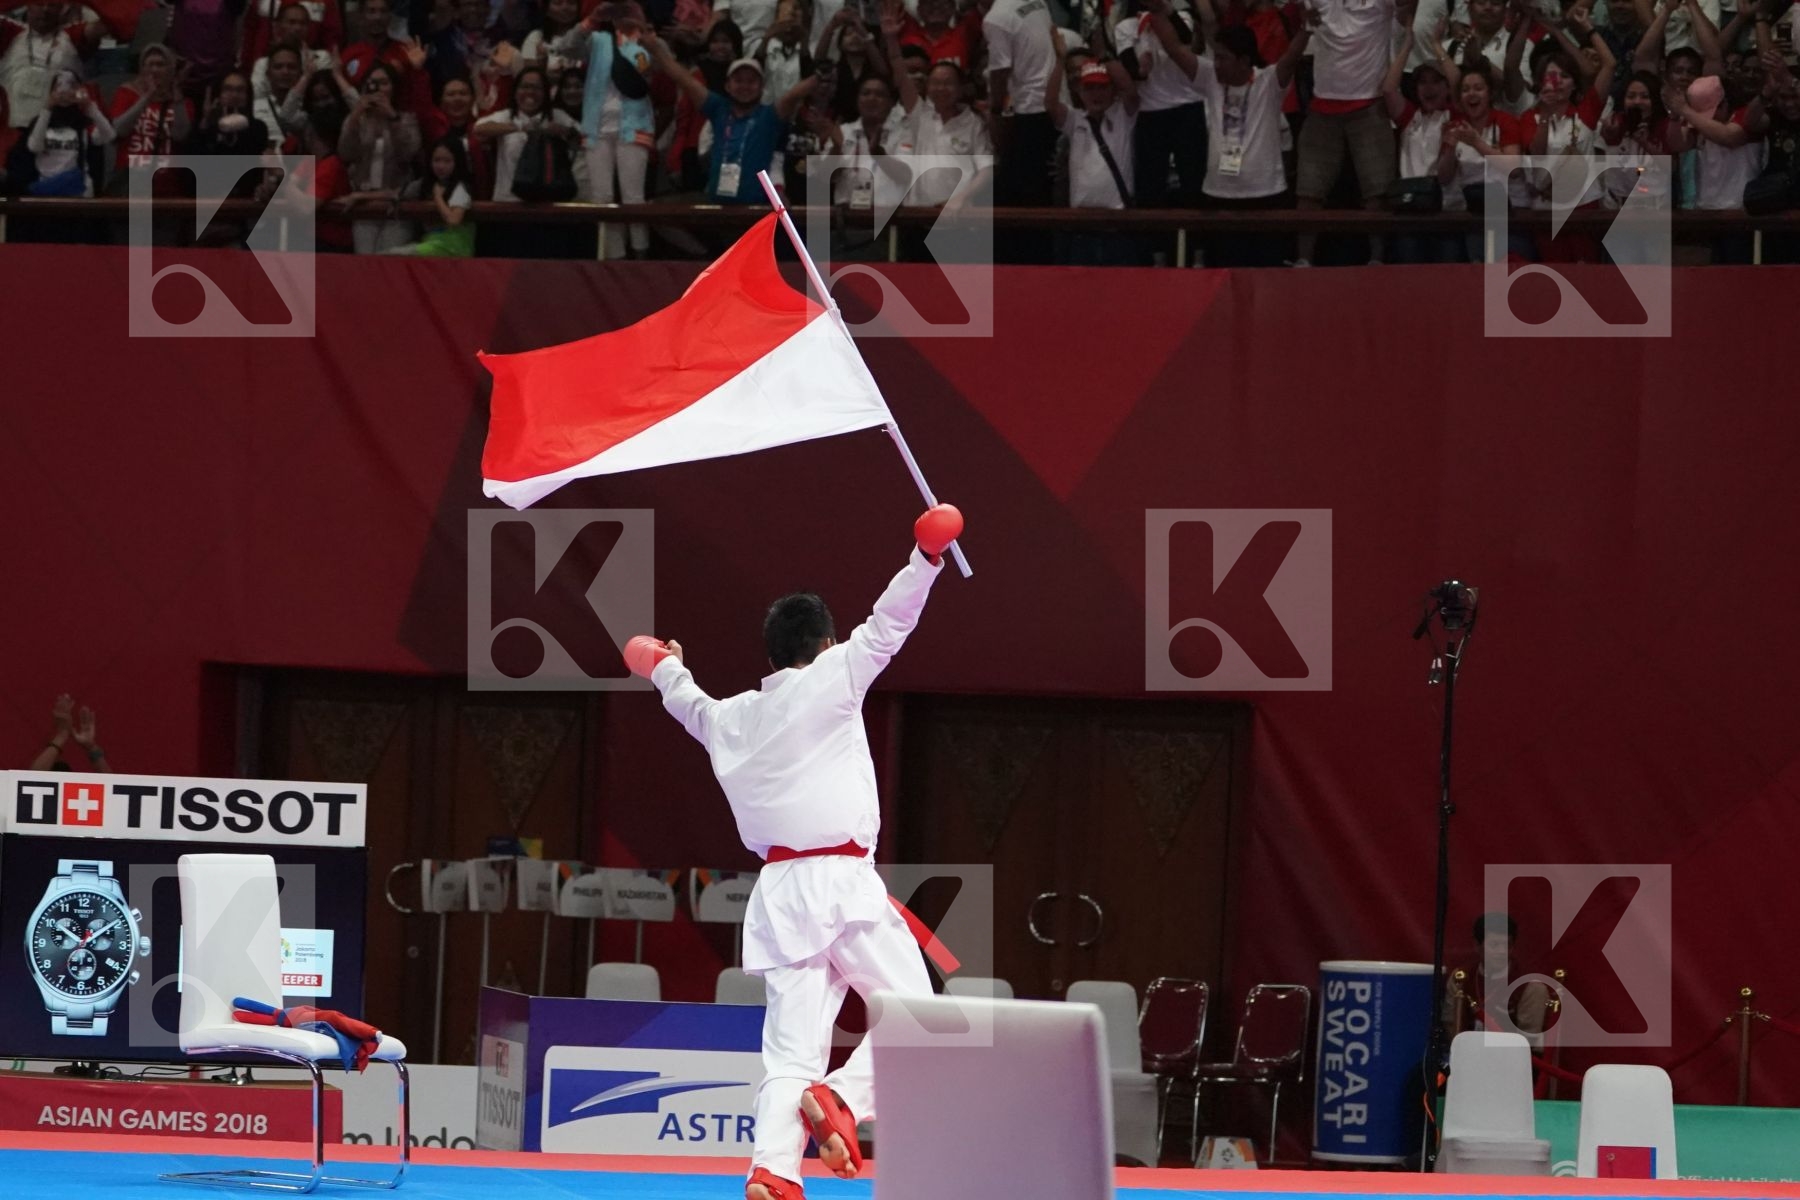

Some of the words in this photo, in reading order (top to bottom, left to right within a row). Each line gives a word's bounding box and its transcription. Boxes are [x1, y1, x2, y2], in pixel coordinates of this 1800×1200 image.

[112, 784, 357, 835] TISSOT
[78, 898, 90, 907] 12
[60, 904, 69, 912] 11
[101, 904, 106, 913] 1
[45, 918, 55, 927] 10
[39, 938, 46, 947] 9
[119, 941, 126, 950] 3
[43, 959, 51, 968] 8
[112, 961, 119, 970] 4
[58, 975, 66, 983] 7
[97, 976, 104, 985] 5
[282, 975, 318, 985] EEPER
[77, 981, 85, 990] 6
[1323, 980, 1346, 1129] SWEAT
[1342, 981, 1371, 1143] POCARI
[482, 1082, 520, 1130] TISSOT
[37, 1105, 112, 1128] ASIAN
[119, 1108, 208, 1132] GAMES
[214, 1112, 268, 1135] 2018
[657, 1113, 756, 1143] ASTR
